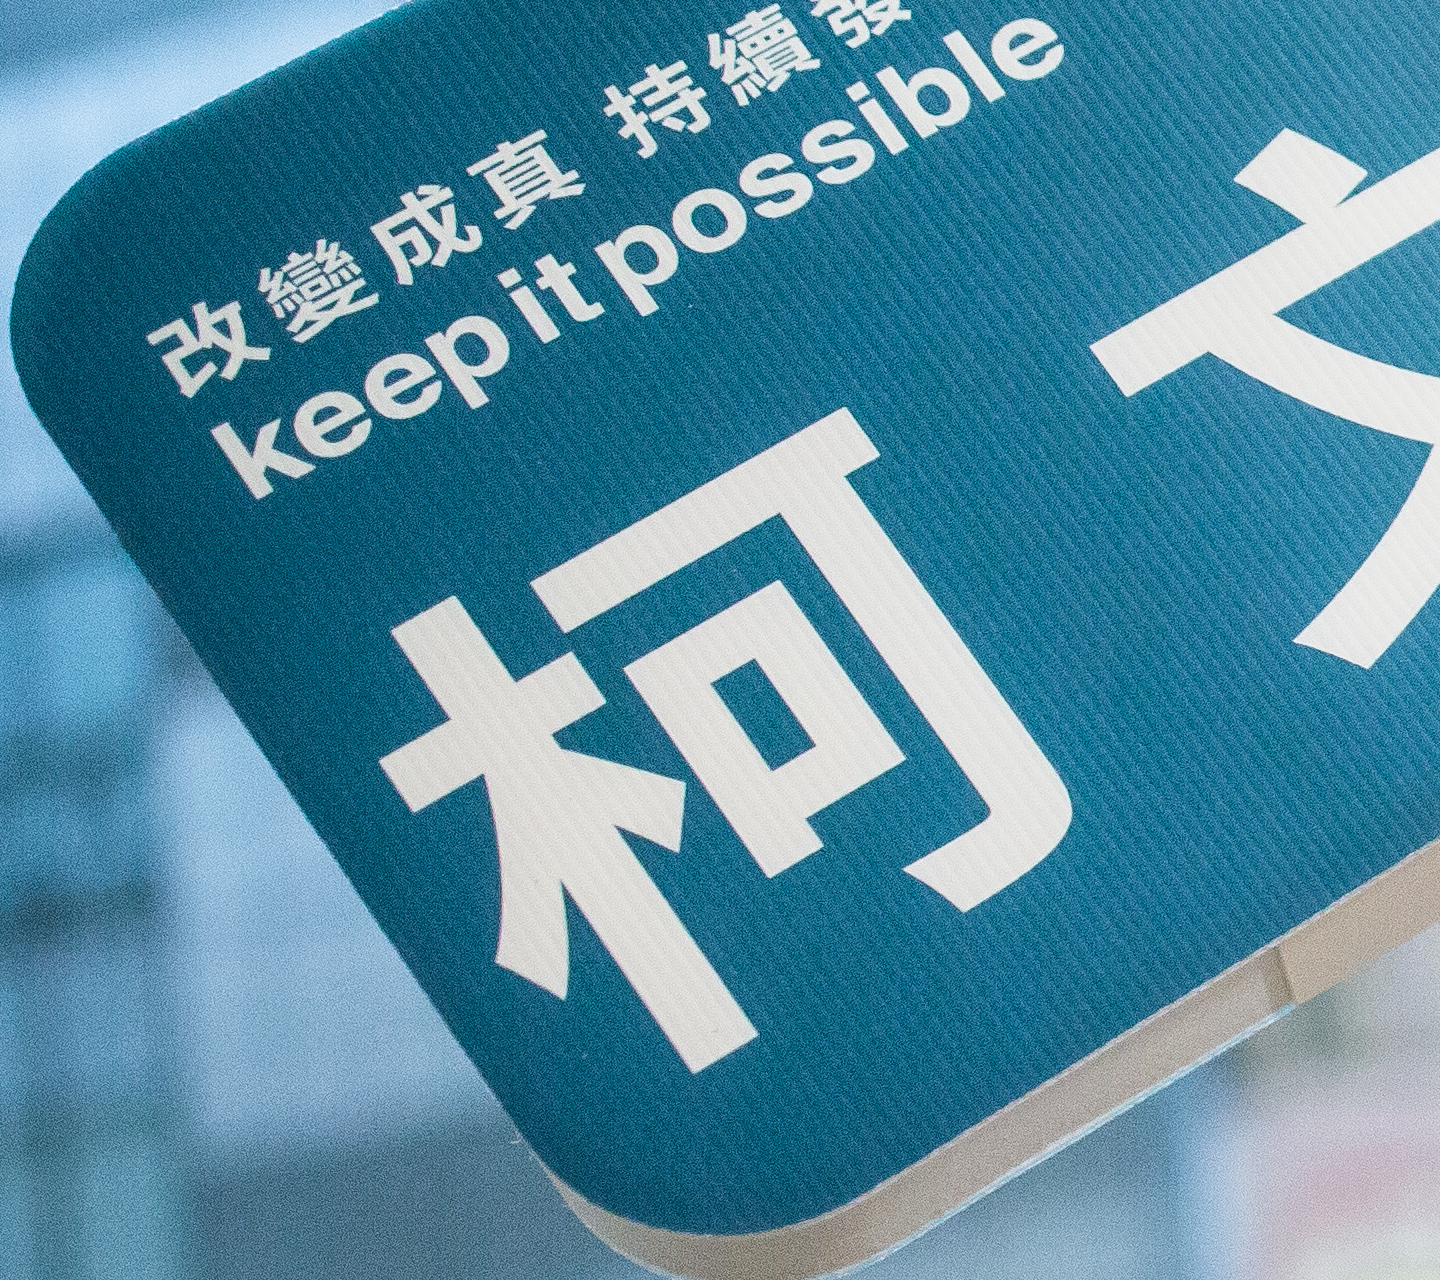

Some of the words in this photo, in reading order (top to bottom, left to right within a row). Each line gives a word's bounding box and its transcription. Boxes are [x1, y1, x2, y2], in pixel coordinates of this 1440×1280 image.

[147, 129, 585, 398] 改變成真
[211, 315, 511, 500] keep
[497, 252, 605, 344] it
[595, 17, 1066, 317] possible
